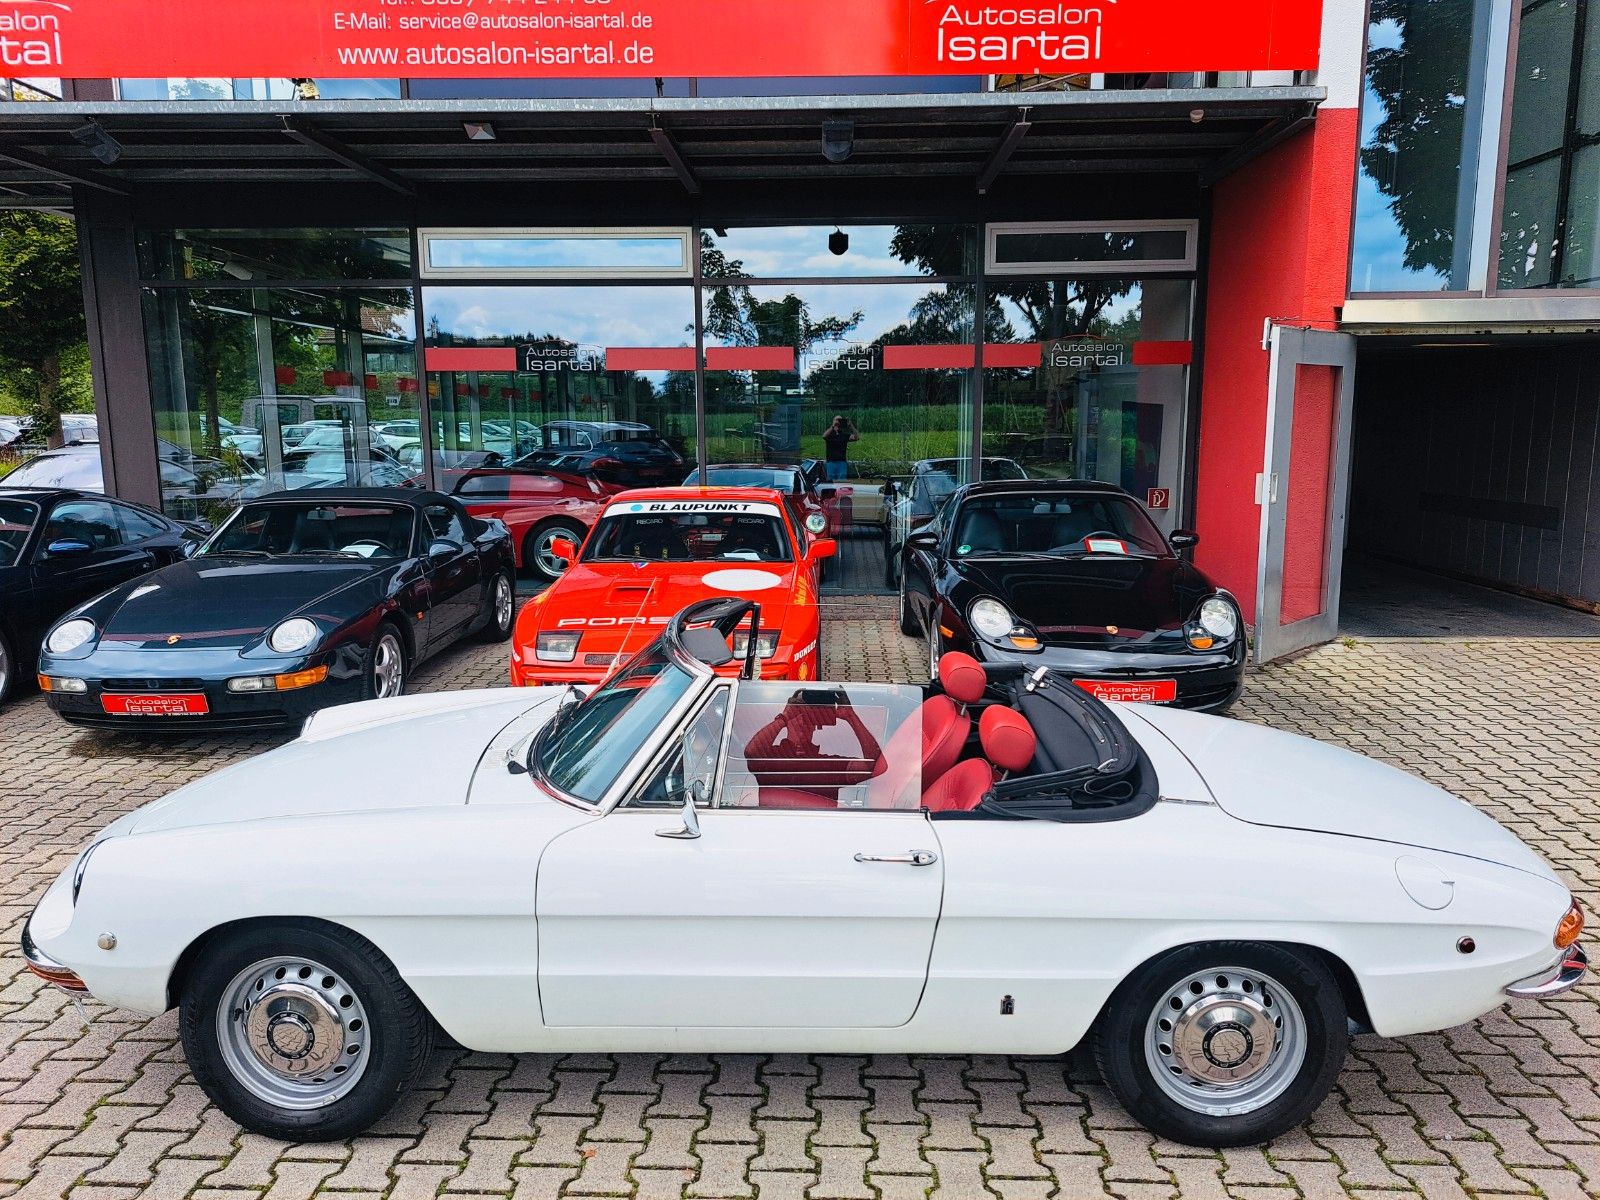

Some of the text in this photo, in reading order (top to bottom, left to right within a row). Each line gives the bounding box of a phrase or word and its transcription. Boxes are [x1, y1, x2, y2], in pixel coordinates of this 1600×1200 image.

[334, 11, 653, 30] E-Mail: service@autosalon-isartal.de
[939, 3, 1102, 26] Autosalon
[937, 26, 1102, 62] Isartal
[337, 40, 654, 65] www.autosalon-isartal.de
[526, 347, 597, 357] Autosalon
[1051, 342, 1124, 352] Autosalon
[525, 355, 598, 371] Isartal
[802, 354, 875, 370] Isartal
[1050, 351, 1124, 367] Isartal
[649, 503, 751, 512] BLAUPUNKT
